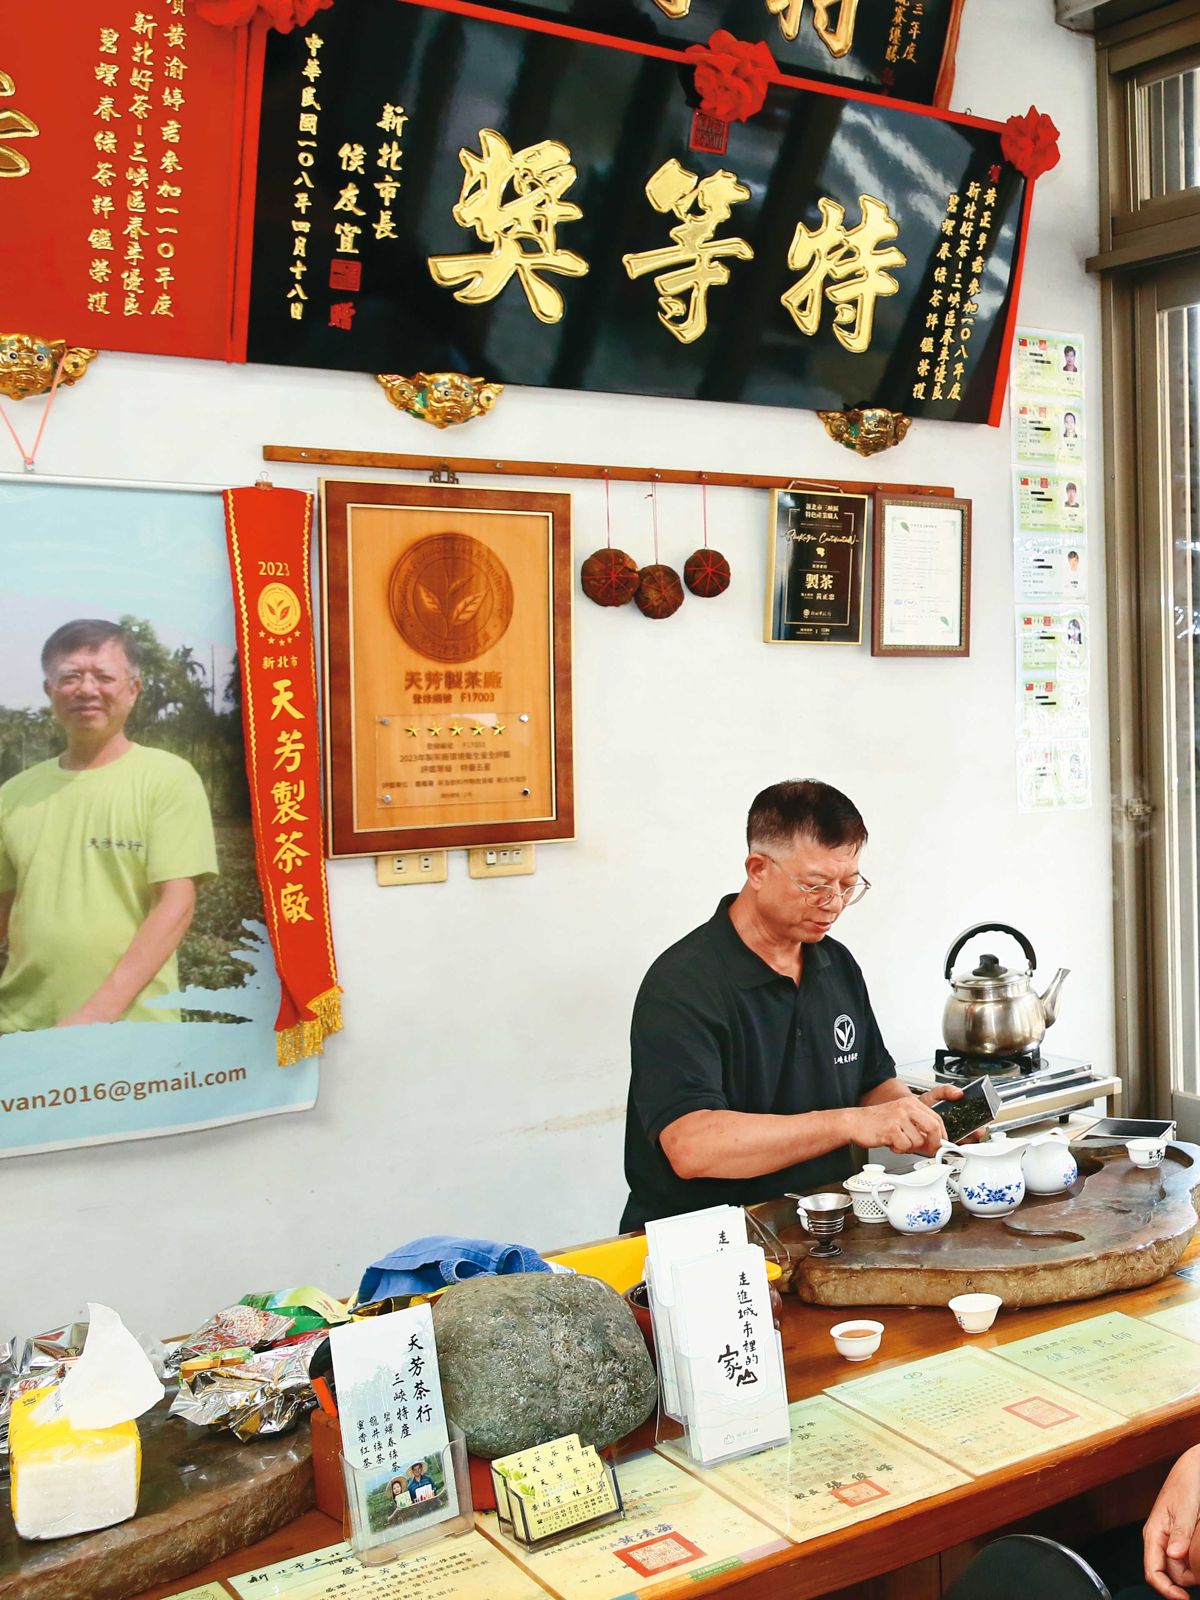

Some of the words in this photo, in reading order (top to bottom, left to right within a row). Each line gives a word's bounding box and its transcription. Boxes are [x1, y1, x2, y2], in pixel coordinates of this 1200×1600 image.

[372, 101, 409, 241] 新北市長
[332, 142, 367, 255] 侯友宜
[804, 572, 835, 590] 製茶
[262, 654, 299, 670] 新北市
[404, 670, 504, 692] 天芳製茶廠
[460, 692, 496, 704] F17003
[1, 1065, 248, 1113] van2016@gmail.com
[407, 1333, 433, 1423] 天芳茶行
[392, 1372, 413, 1440] 三峽特產
[356, 1419, 373, 1469] 蜜香紅茶
